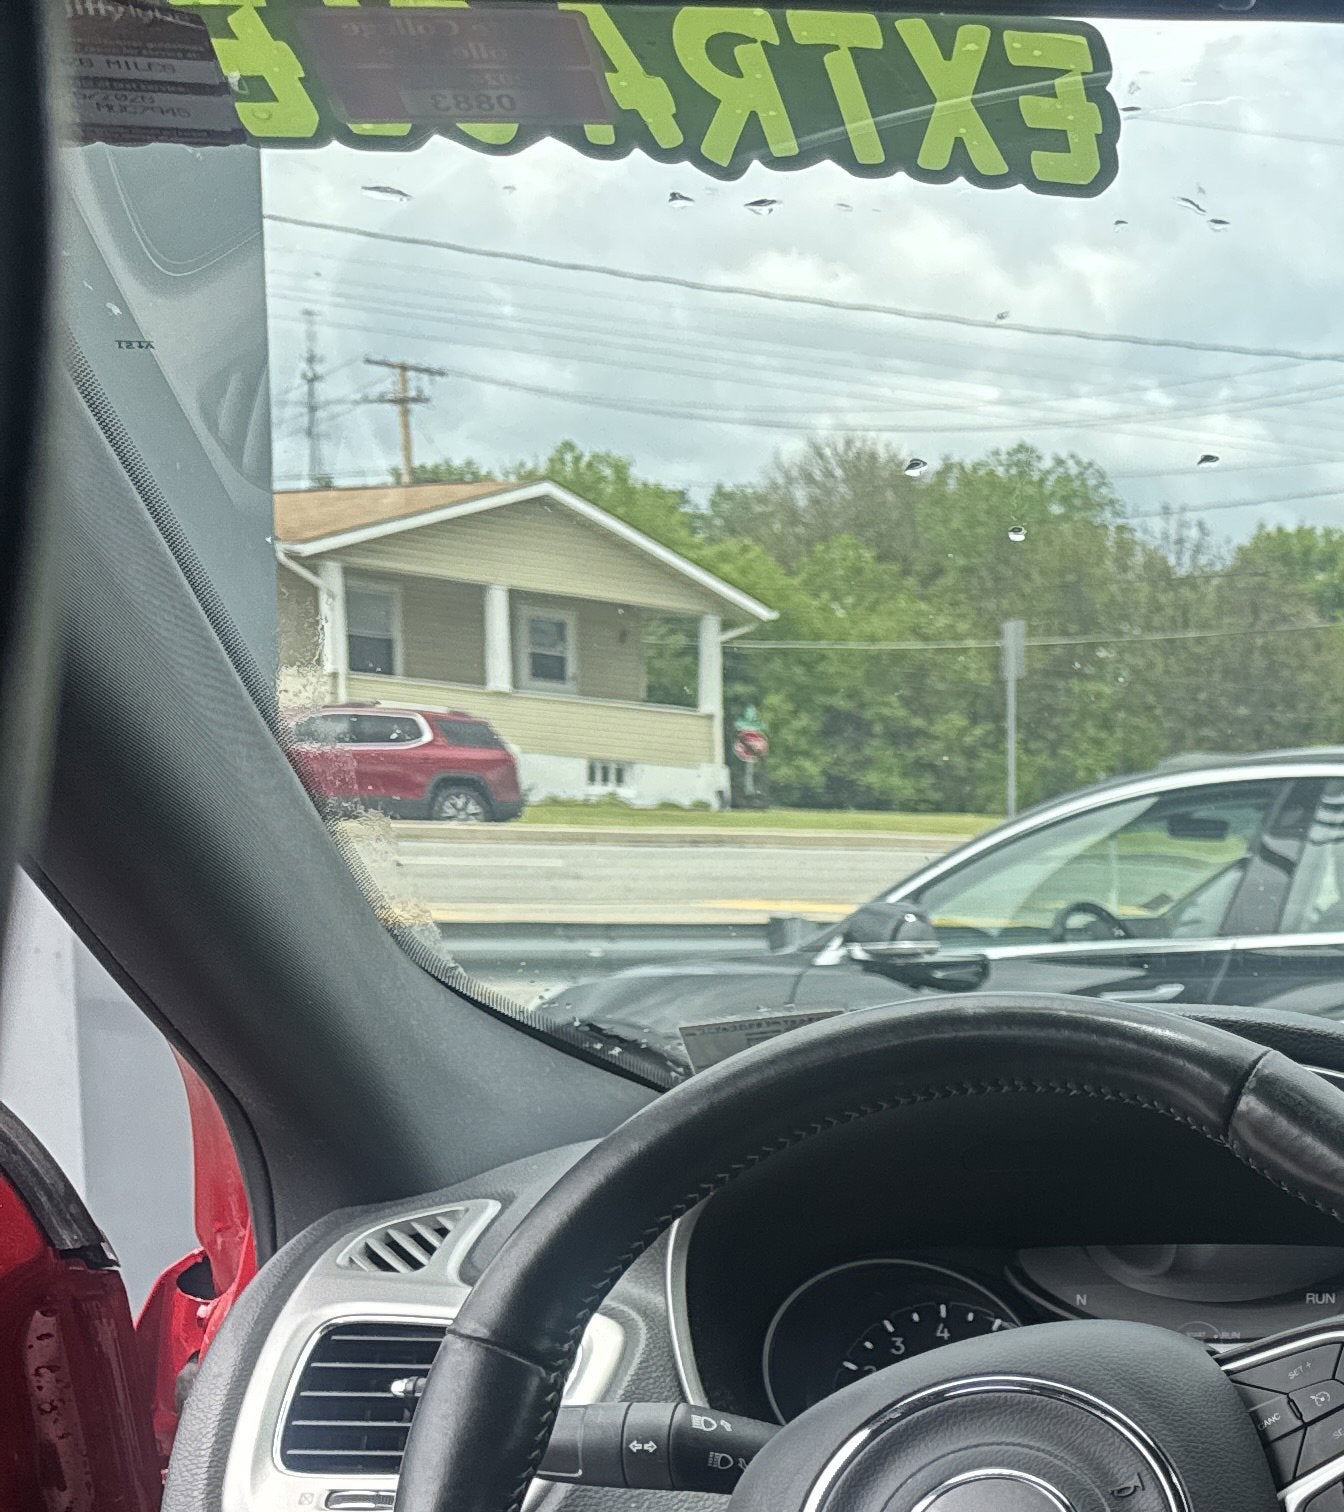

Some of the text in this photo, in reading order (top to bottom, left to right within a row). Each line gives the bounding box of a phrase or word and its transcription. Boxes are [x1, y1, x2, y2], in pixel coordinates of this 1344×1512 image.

[1075, 1294, 1087, 1306] N
[1306, 1293, 1336, 1305] RUN
[935, 1323, 950, 1341] 4
[890, 1337, 905, 1355] 3
[1287, 1365, 1305, 1380] SET
